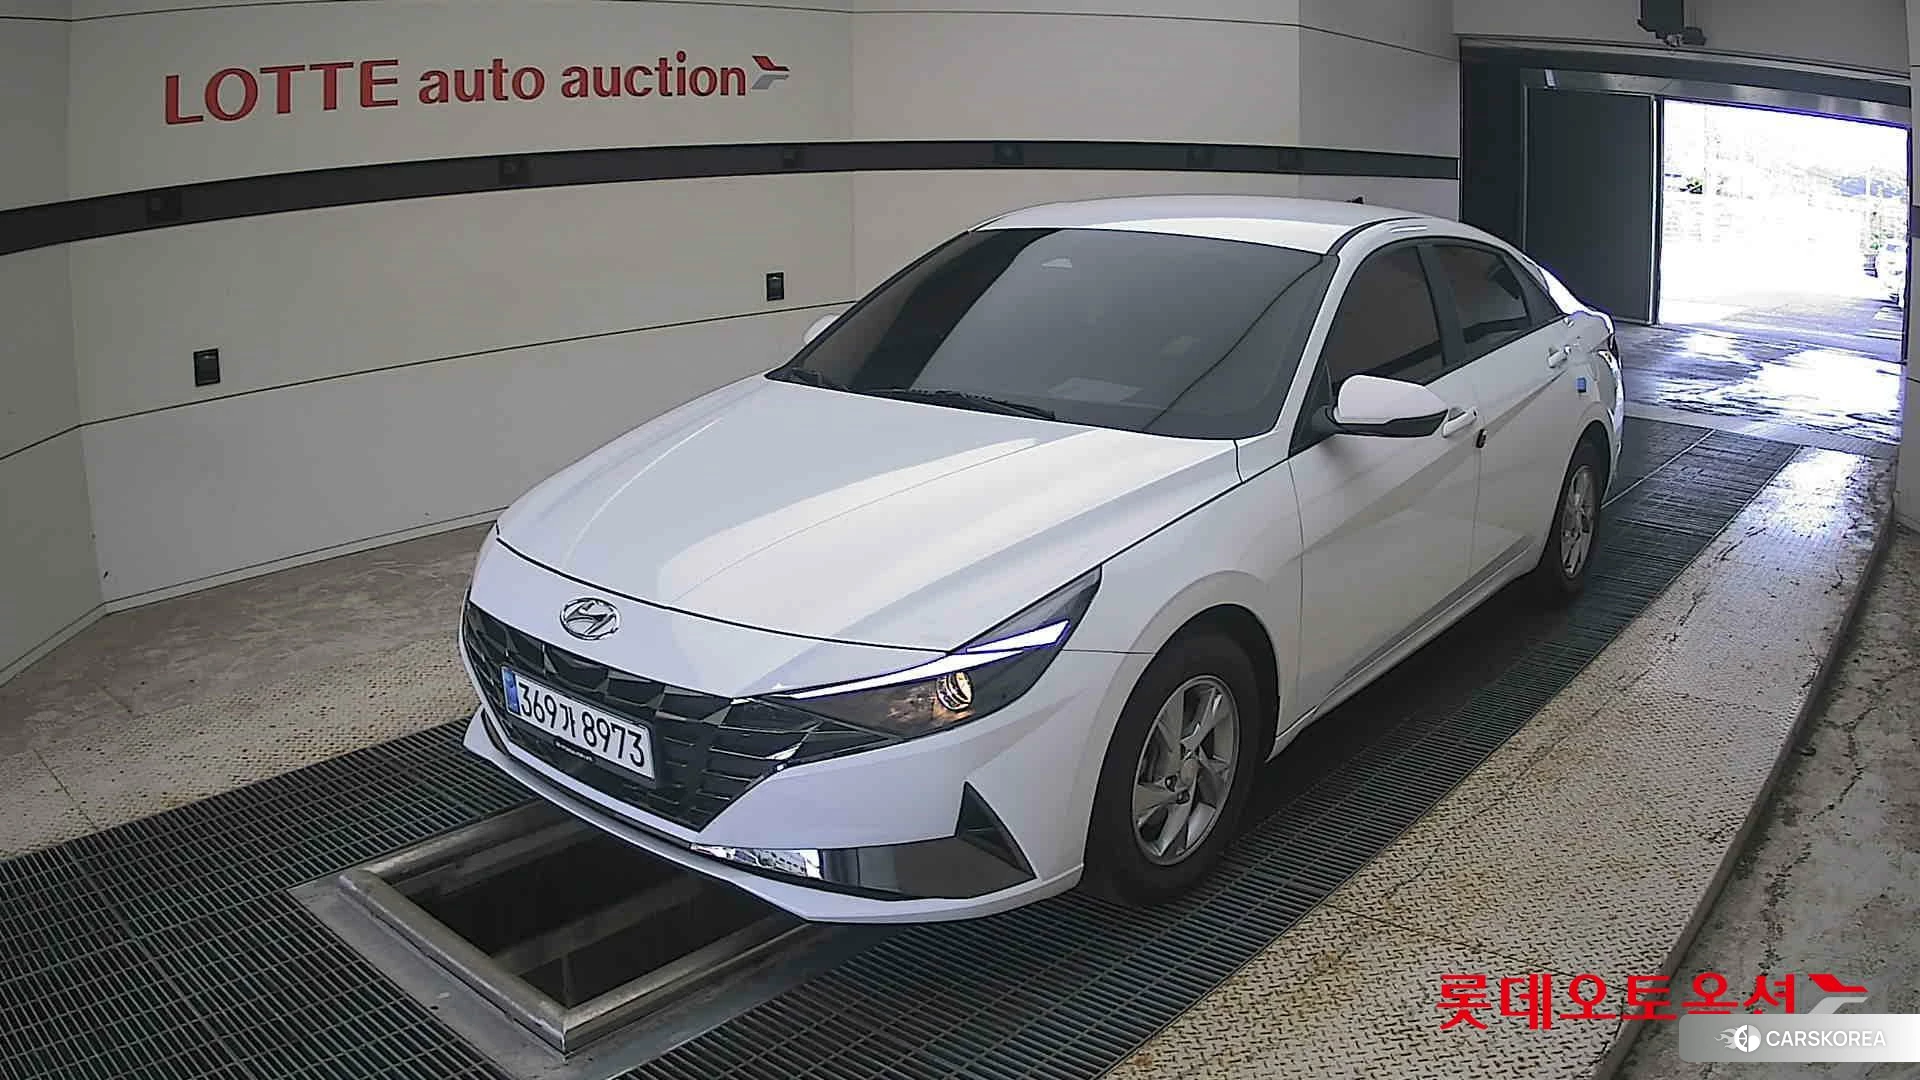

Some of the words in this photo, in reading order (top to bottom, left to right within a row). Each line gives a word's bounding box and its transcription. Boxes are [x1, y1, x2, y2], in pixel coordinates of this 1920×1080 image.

[164, 58, 400, 125] LOTTE
[418, 57, 546, 104] auto
[561, 50, 747, 98] auction
[581, 711, 646, 768] 8973
